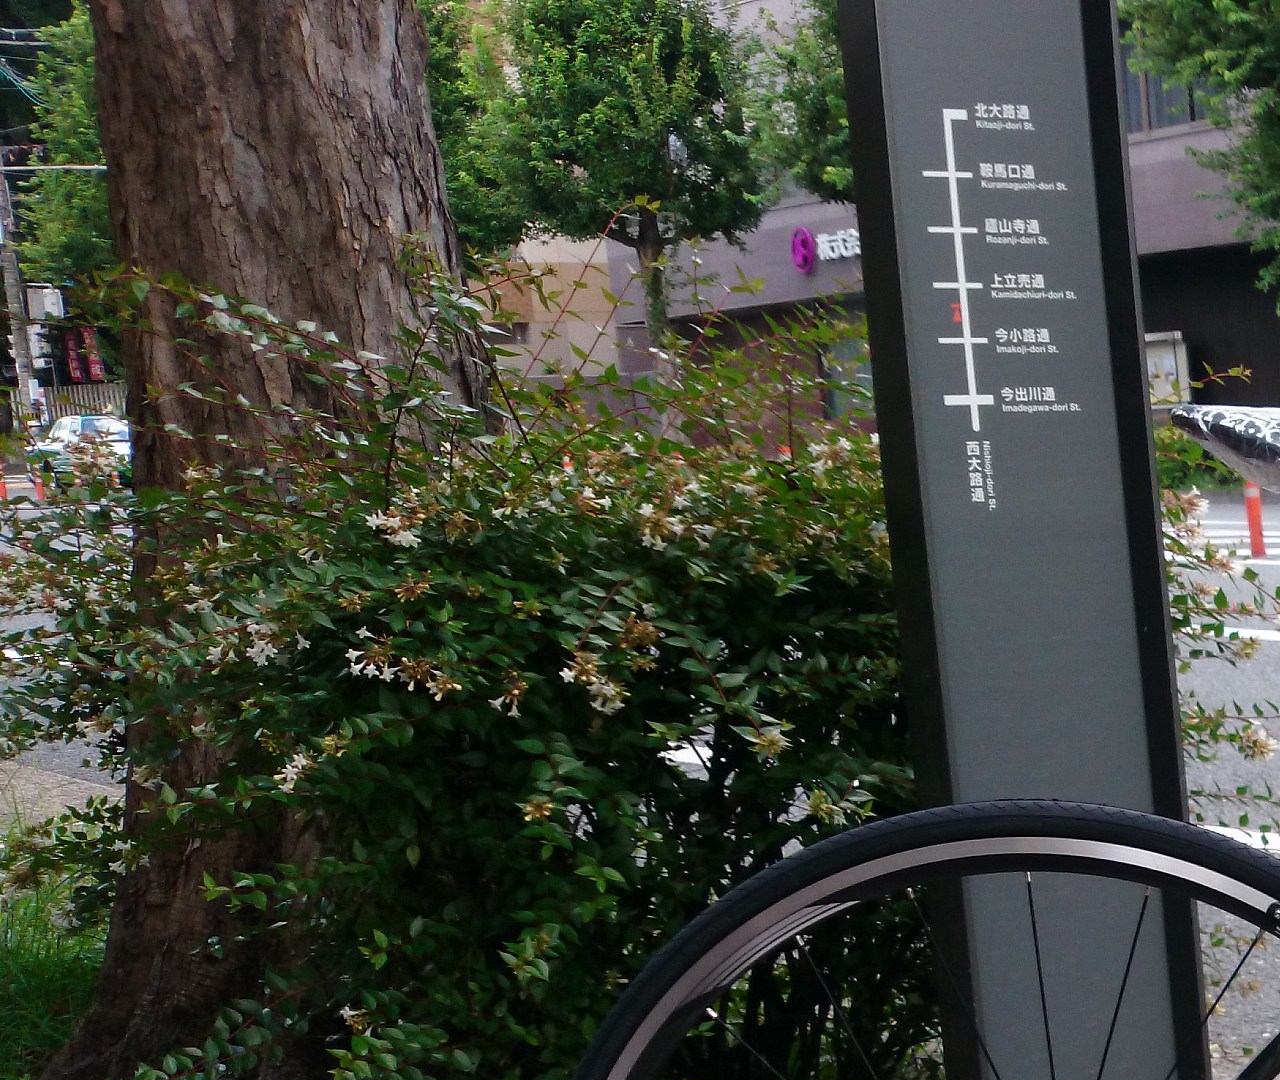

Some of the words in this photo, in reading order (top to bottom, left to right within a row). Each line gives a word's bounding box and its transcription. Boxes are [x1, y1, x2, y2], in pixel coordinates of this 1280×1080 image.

[974, 102, 1030, 120] 北大路通
[975, 120, 1022, 131] Kitaoji-dori
[1023, 120, 1036, 131] St.
[979, 162, 1035, 180] 鞍馬口通
[1056, 181, 1069, 191] St.
[986, 234, 1037, 246] Rozanji-dori
[1037, 235, 1051, 245] St.
[990, 272, 1045, 289] 上立売通
[1065, 290, 1078, 300] St.
[994, 328, 1051, 343] 今小路通
[996, 344, 1047, 355] Imakoji-dori
[1047, 344, 1060, 354] St.
[1000, 386, 1056, 402] 今出川通
[1002, 403, 1069, 414] Imadegawa-dori
[1069, 402, 1082, 412] St.
[965, 441, 986, 503] 西大路通
[982, 440, 996, 497] Nishioji-dori
